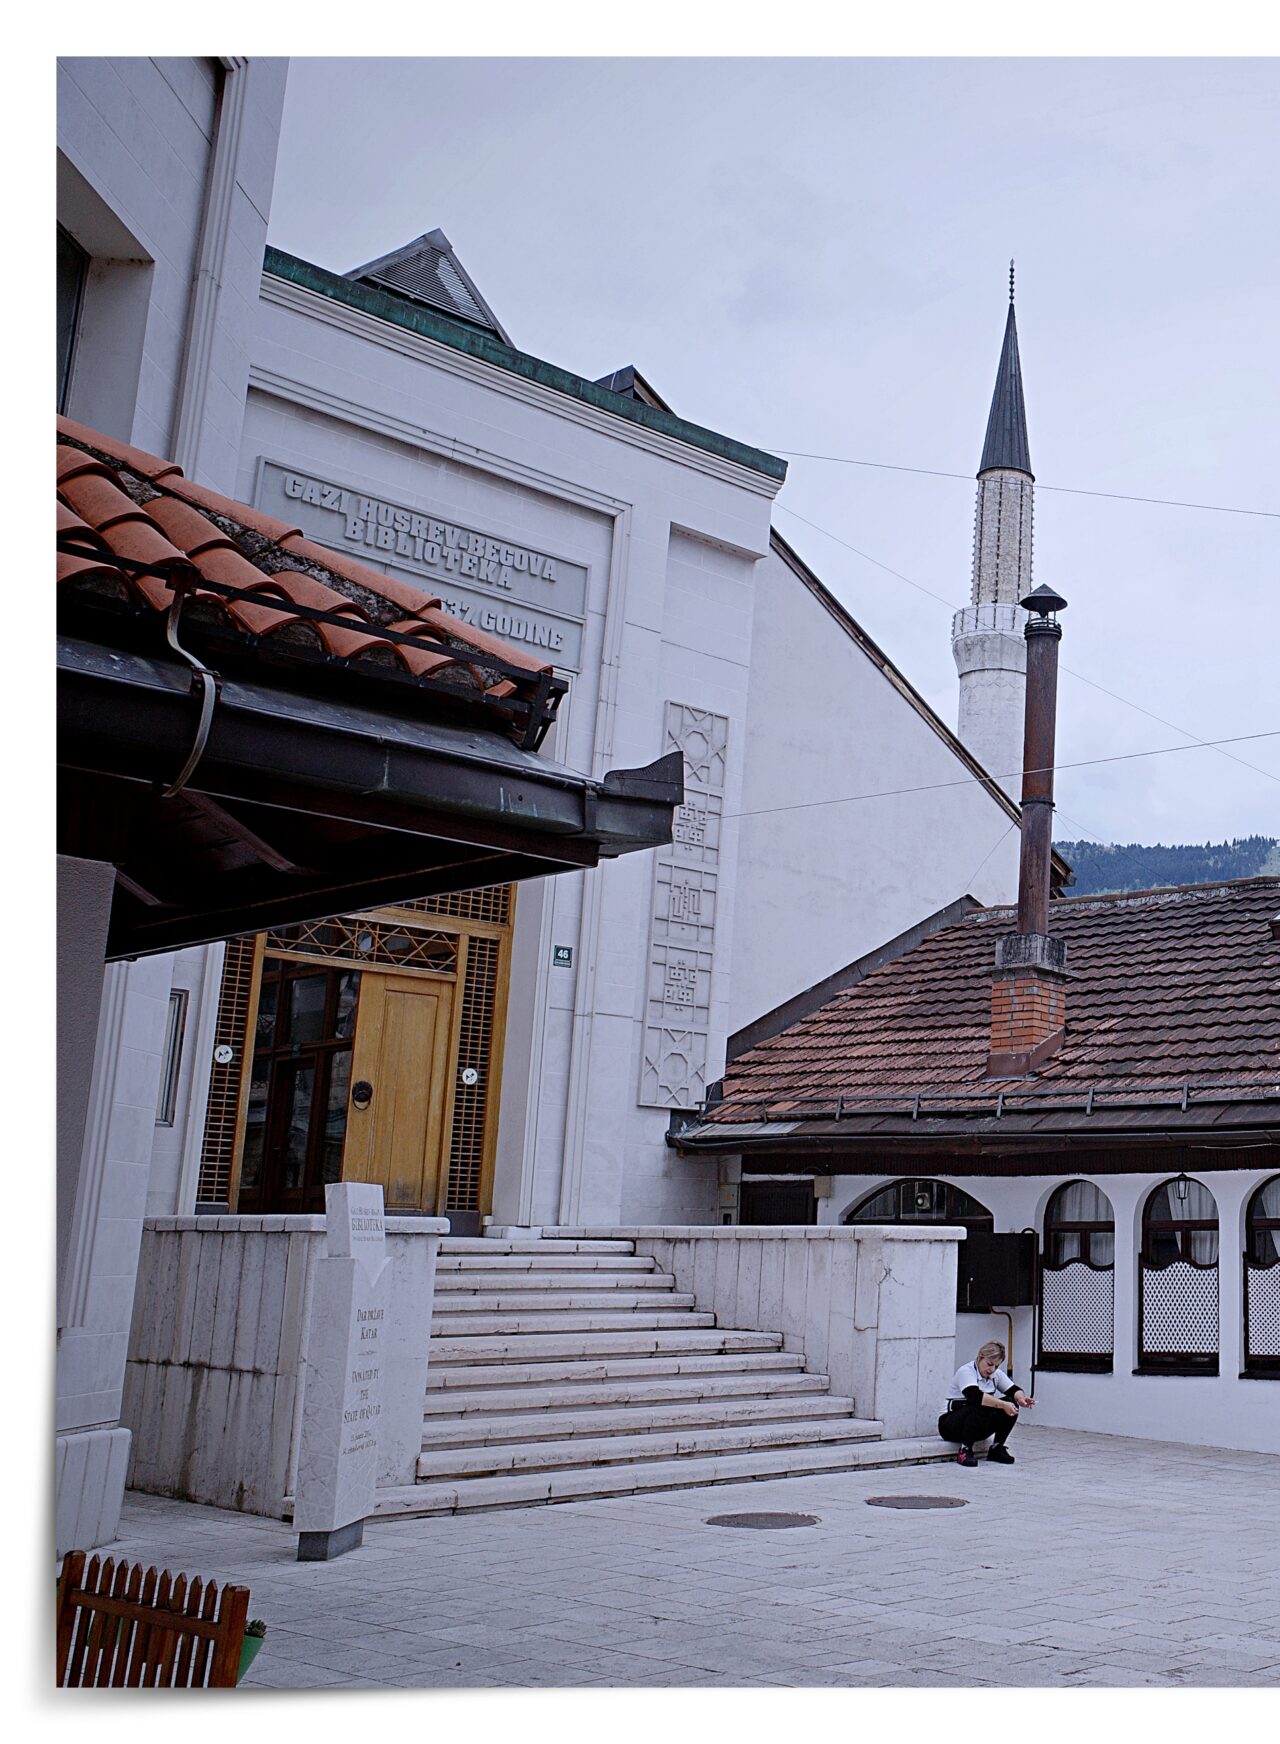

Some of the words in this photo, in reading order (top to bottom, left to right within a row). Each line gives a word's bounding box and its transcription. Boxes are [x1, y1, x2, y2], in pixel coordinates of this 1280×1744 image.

[284, 473, 349, 515] GAZI
[358, 498, 559, 583] HUSREV-BEGOVA
[345, 517, 514, 590] BIBLIOTEKA
[479, 608, 564, 652] GODINE
[557, 949, 569, 959] 46
